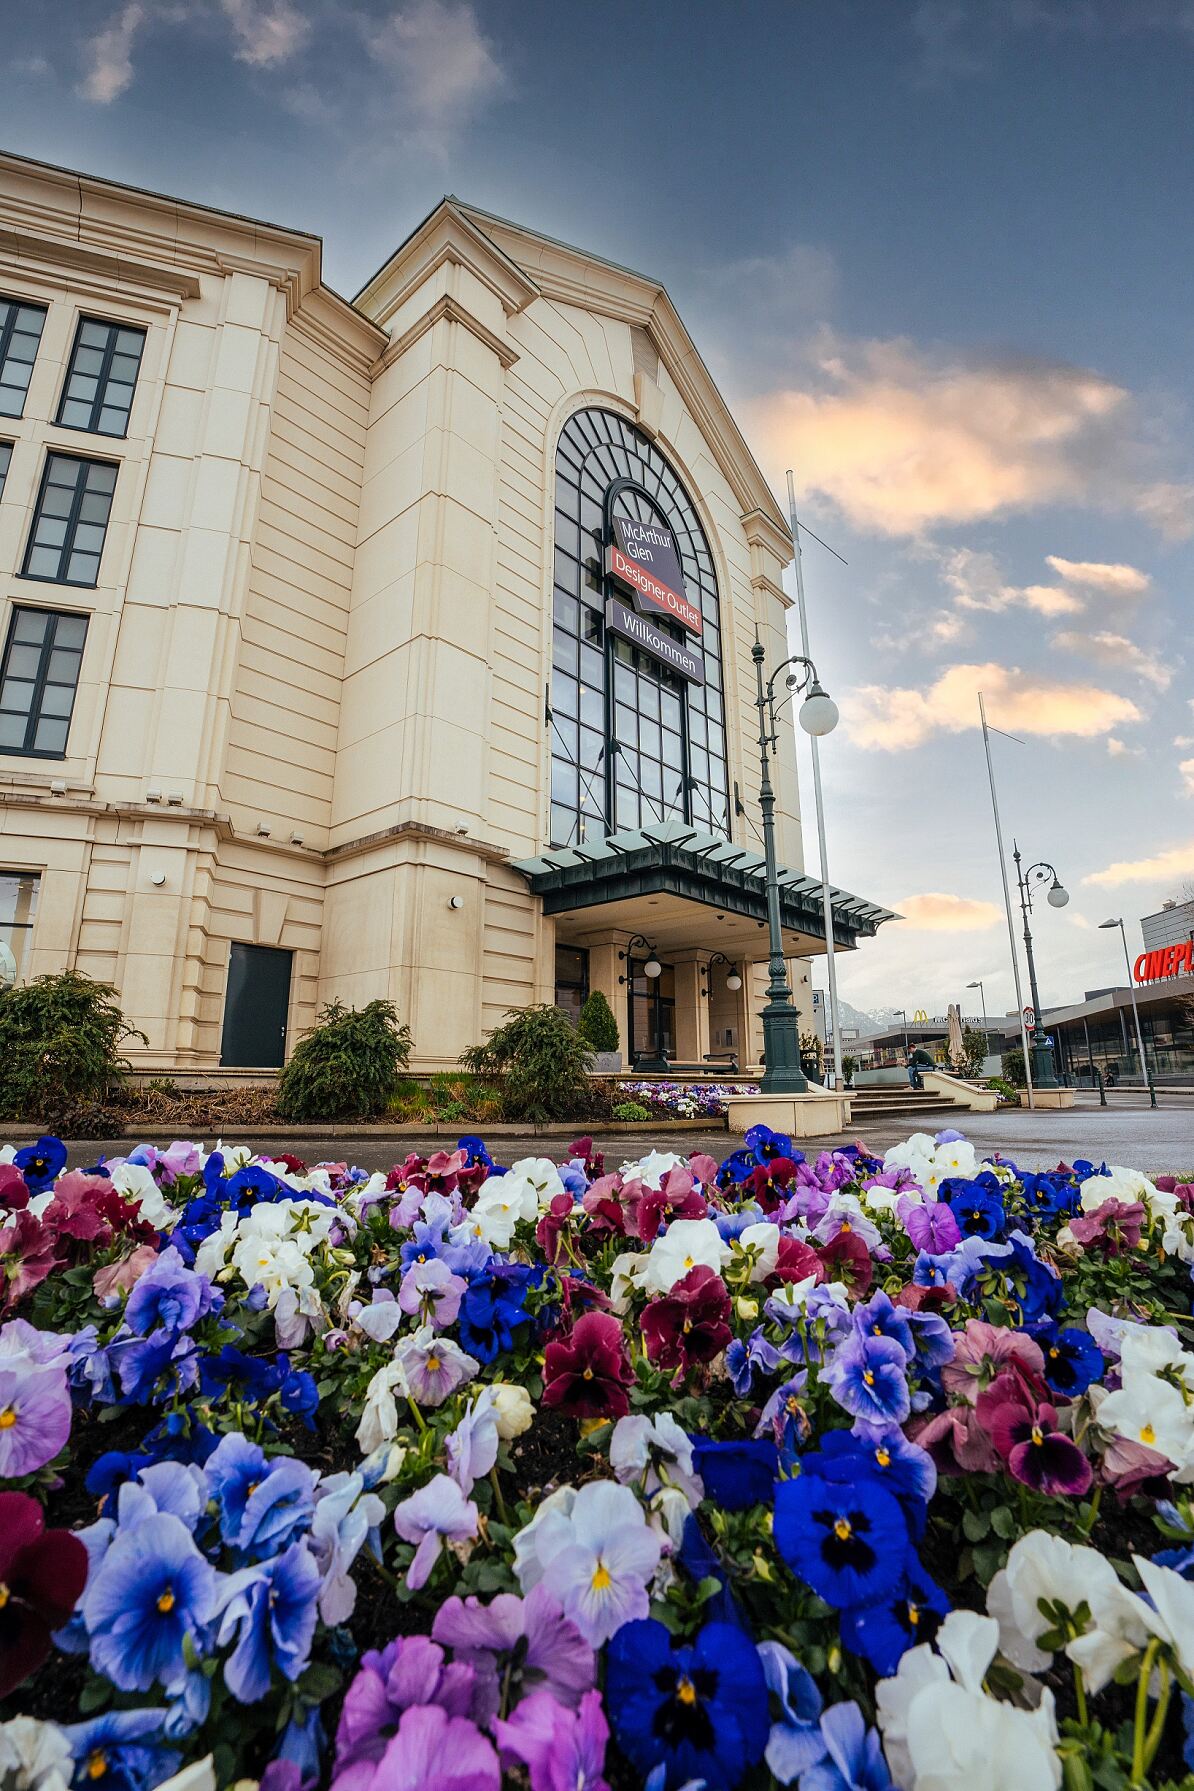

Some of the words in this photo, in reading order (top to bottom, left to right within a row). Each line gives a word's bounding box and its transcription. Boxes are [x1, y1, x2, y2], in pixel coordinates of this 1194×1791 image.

[621, 521, 671, 549] McArthur
[627, 541, 654, 562] Glen
[615, 553, 667, 599] Designer
[667, 593, 699, 627] Outlet
[622, 611, 696, 673] Willkommen
[1024, 1012, 1034, 1024] 30
